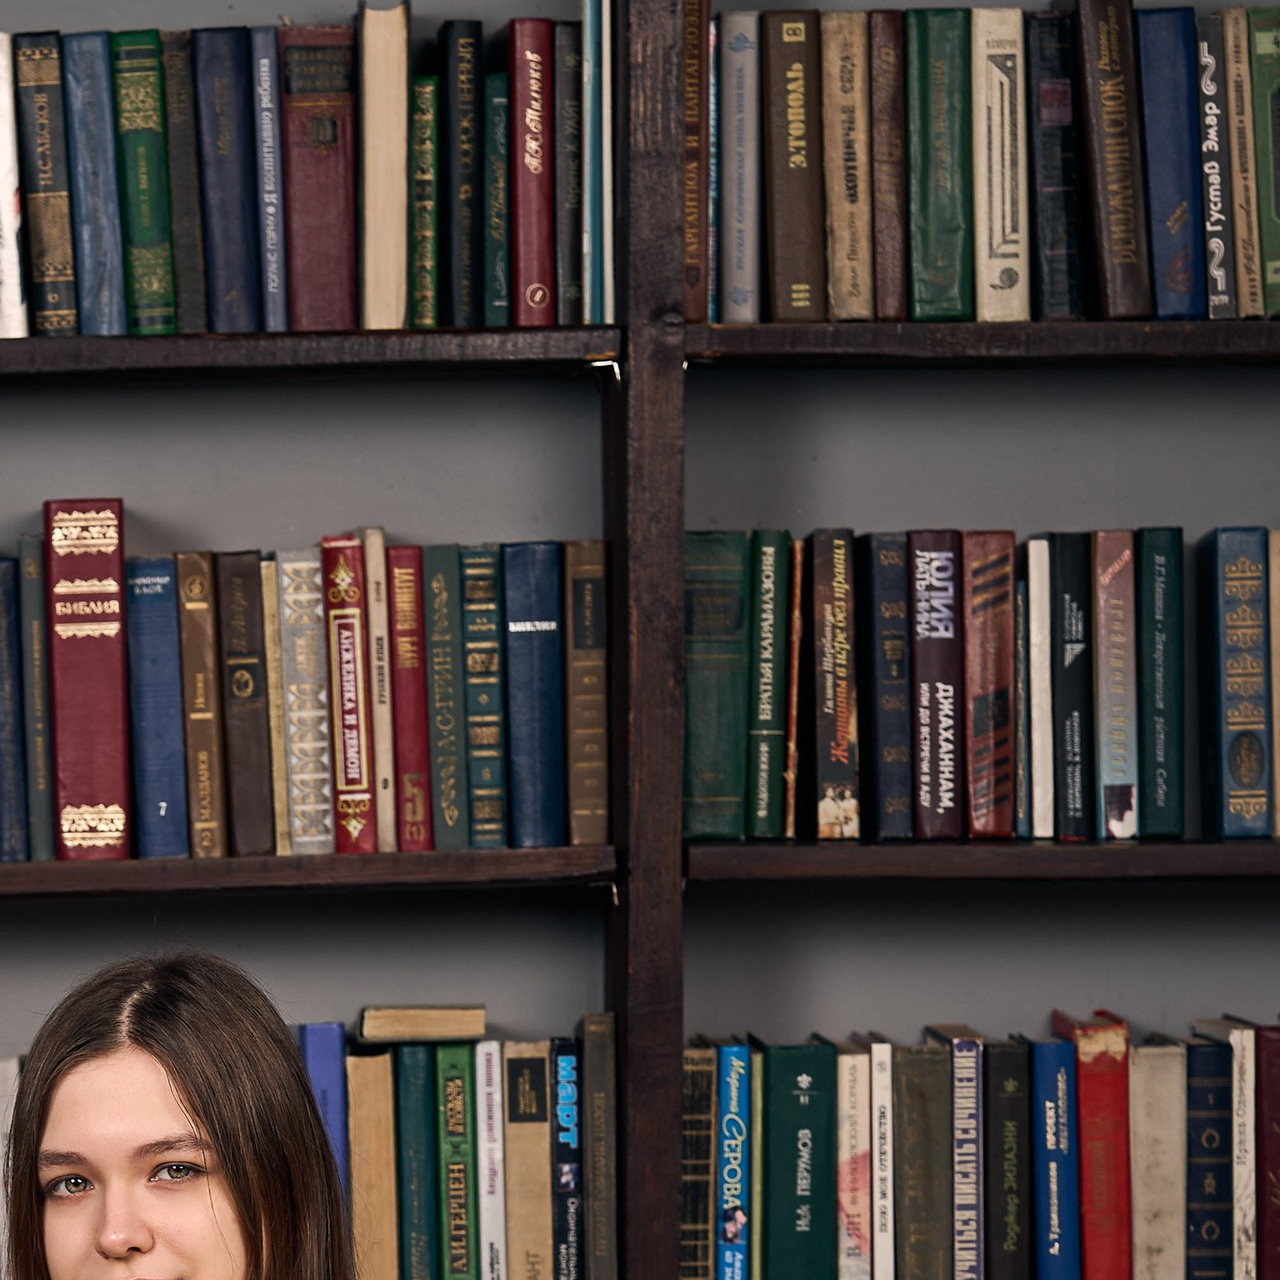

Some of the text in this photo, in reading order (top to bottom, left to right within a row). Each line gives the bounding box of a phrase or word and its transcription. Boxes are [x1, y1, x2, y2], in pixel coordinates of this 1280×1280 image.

[786, 63, 807, 168] Э.ТОПОЛЬ
[1099, 74, 1137, 264] БЕНДЖАМИН СПОК
[1201, 102, 1225, 231] Густав Эмар
[831, 539, 849, 598] правил
[916, 550, 931, 639] ЛАТЫНИНА
[930, 552, 954, 640] ЮЛИЯ
[55, 599, 120, 616] БИБЛИЯ
[758, 547, 776, 720] БРАТЬЯ КАРАМАЗОВЫ
[830, 602, 846, 626] без
[836, 629, 851, 664] игре
[340, 629, 360, 779] АНЖЕЛИКА И ДЕМОН
[830, 681, 850, 764] Женщины
[919, 682, 929, 703] ИЛИ
[920, 726, 930, 772] ВСТРЕЧИ
[920, 776, 929, 784] В
[936, 682, 955, 814] ДЖАХАННАМ,
[920, 786, 930, 807] АДУ
[954, 1047, 977, 1139] СОЧИНЕНИЕ
[797, 1129, 812, 1196] ПЕРУМОВ
[954, 1143, 978, 1204] ПИСАТЬ
